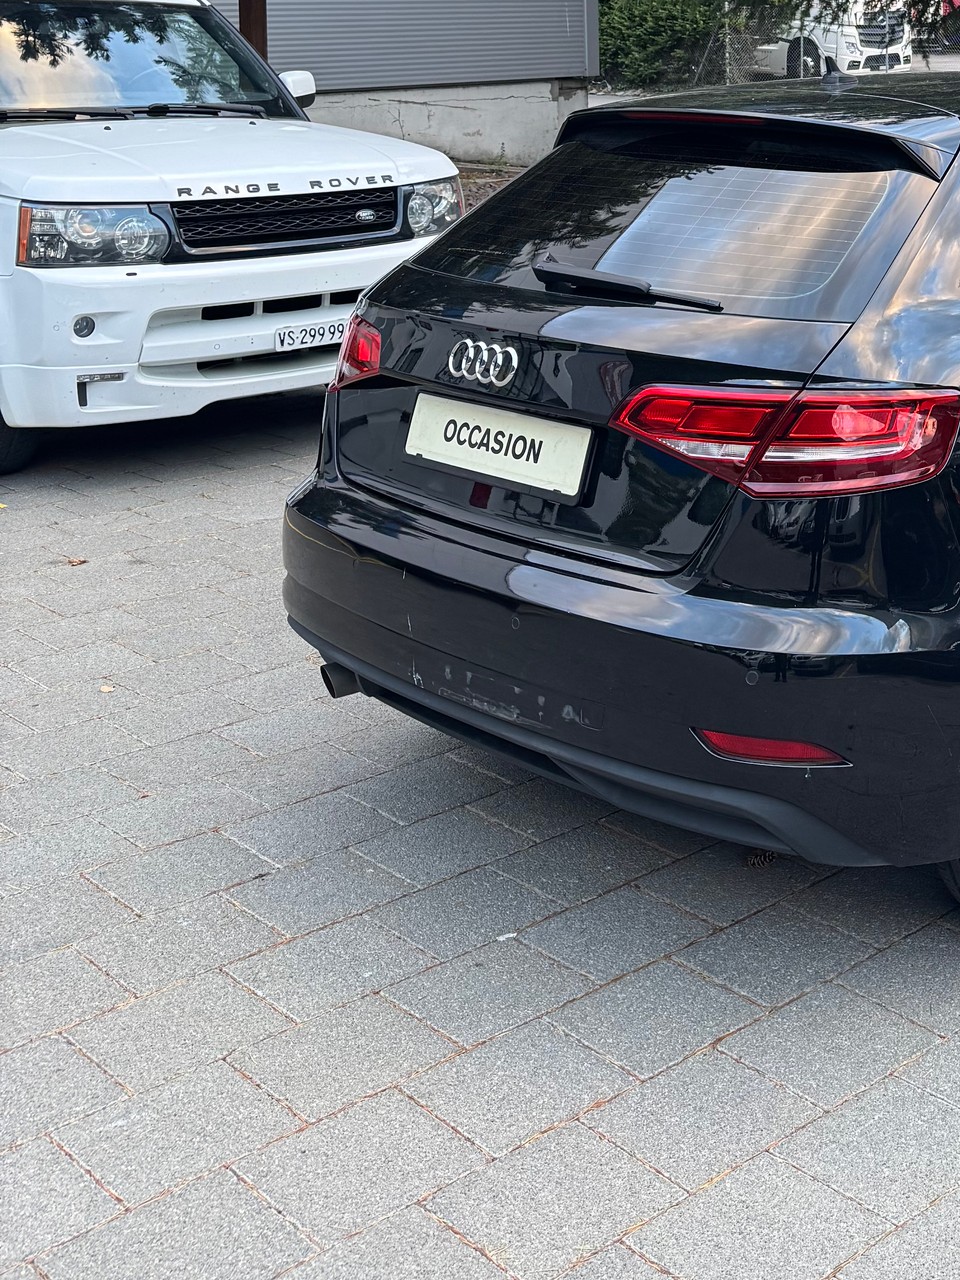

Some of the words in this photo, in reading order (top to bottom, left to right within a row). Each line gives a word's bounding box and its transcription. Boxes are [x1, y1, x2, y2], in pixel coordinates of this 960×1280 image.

[176, 182, 281, 198] RANGE
[308, 174, 395, 190] ROVER
[443, 418, 544, 464] OCCASION
